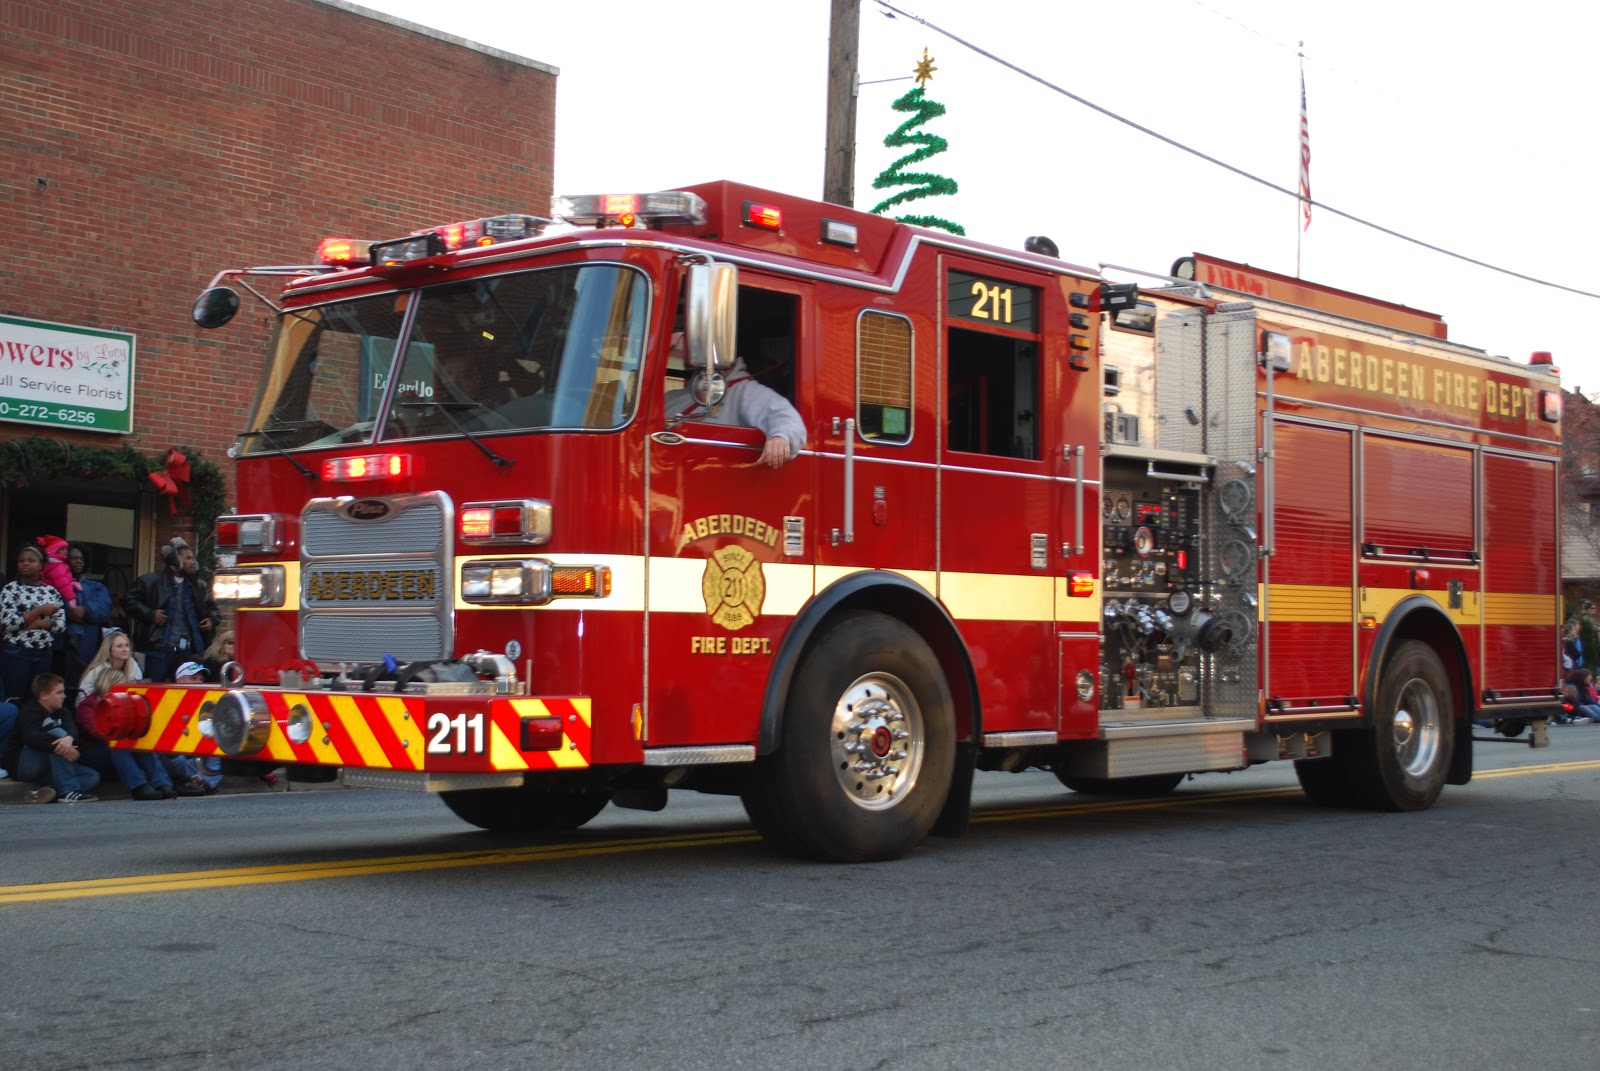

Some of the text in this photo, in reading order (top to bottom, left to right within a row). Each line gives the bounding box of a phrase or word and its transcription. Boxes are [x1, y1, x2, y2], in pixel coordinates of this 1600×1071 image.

[971, 281, 1012, 323] 211
[76, 346, 90, 365] by
[20, 377, 72, 394] Service
[78, 384, 123, 400] Florist
[1297, 341, 1536, 420] ABERDEEN FIRE DEPT.
[0, 402, 96, 424] 0-272-6256
[684, 514, 779, 547] ABERDEEN
[307, 570, 436, 600] ABERDEEN
[691, 636, 772, 654] FIRE DEPT.
[427, 712, 485, 753] 211
